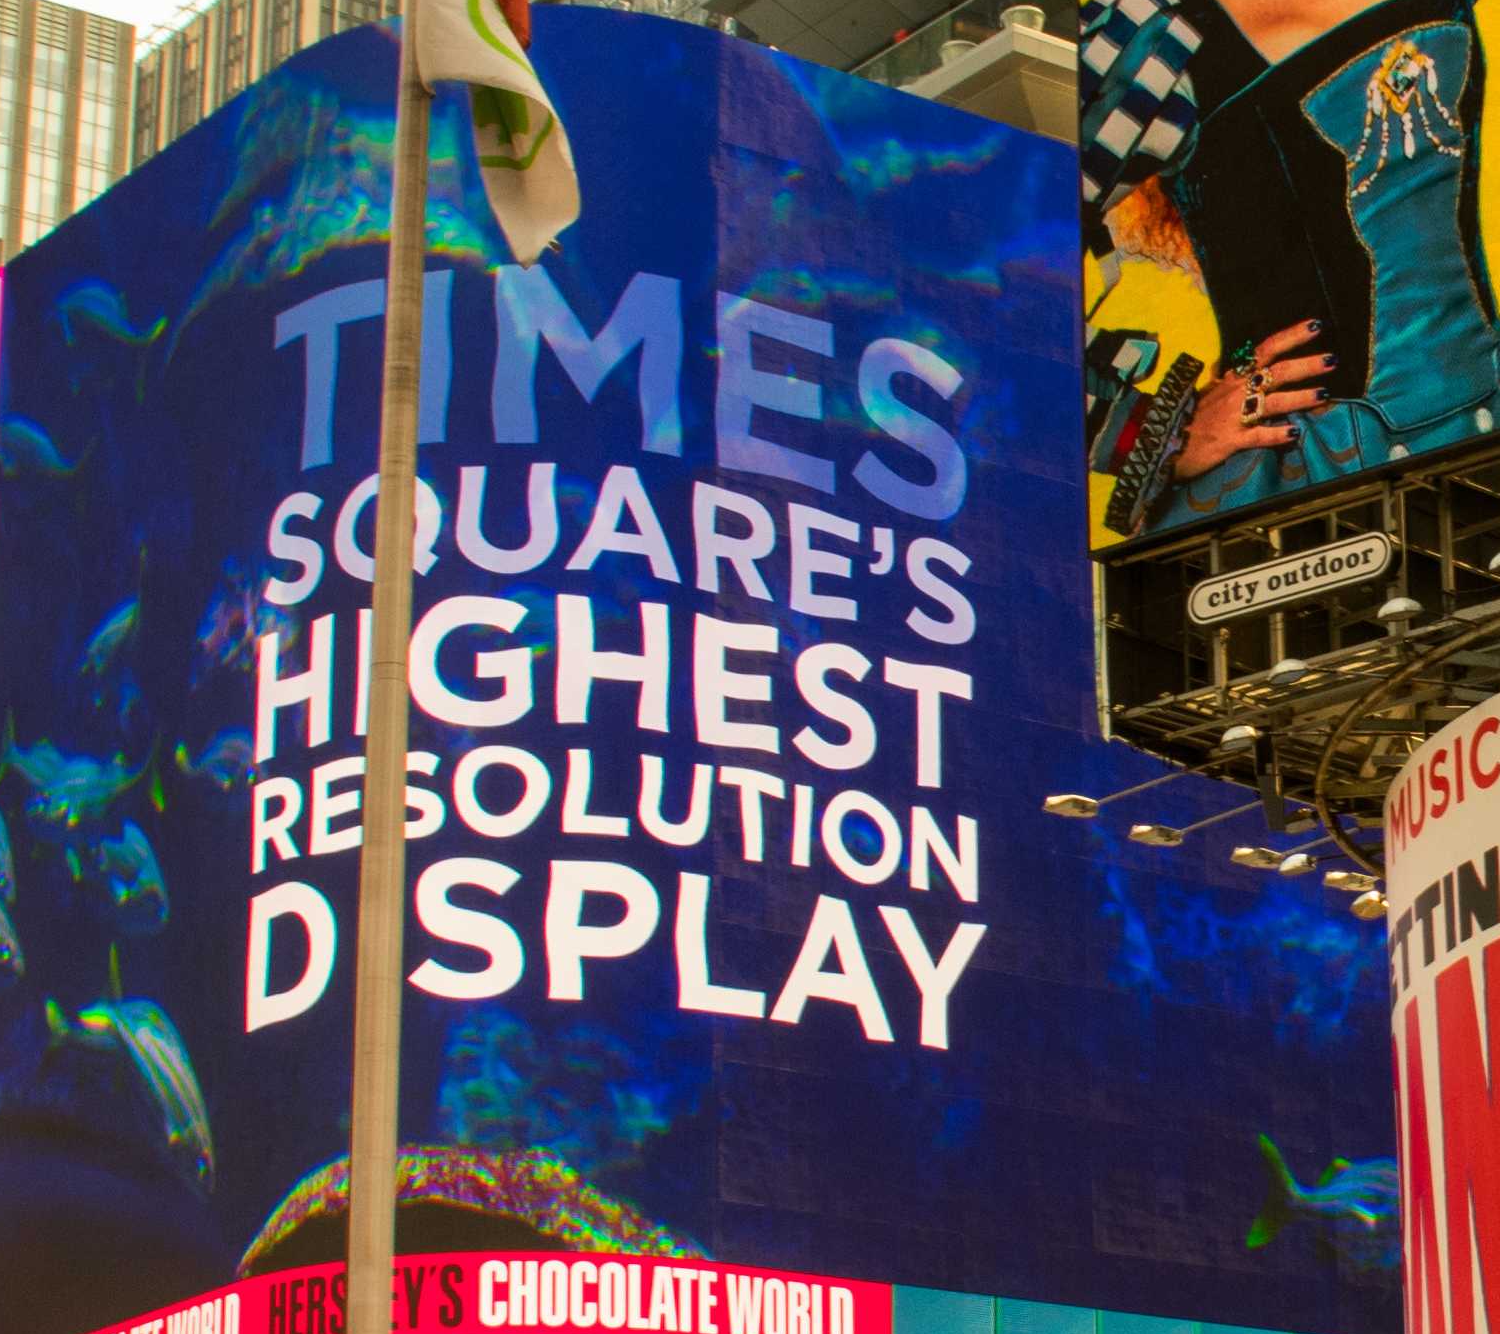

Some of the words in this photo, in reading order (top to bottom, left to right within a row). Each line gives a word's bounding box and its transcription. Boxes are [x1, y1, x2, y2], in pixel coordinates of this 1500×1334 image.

[275, 265, 968, 521] TIMES
[1206, 576, 1260, 609] city
[1266, 545, 1375, 593] outdoor
[255, 594, 974, 788] HIGHEST
[251, 744, 979, 904] RESOLUTION
[245, 857, 988, 1051] DSPLAY
[476, 1259, 717, 1331] CHOCOLATE
